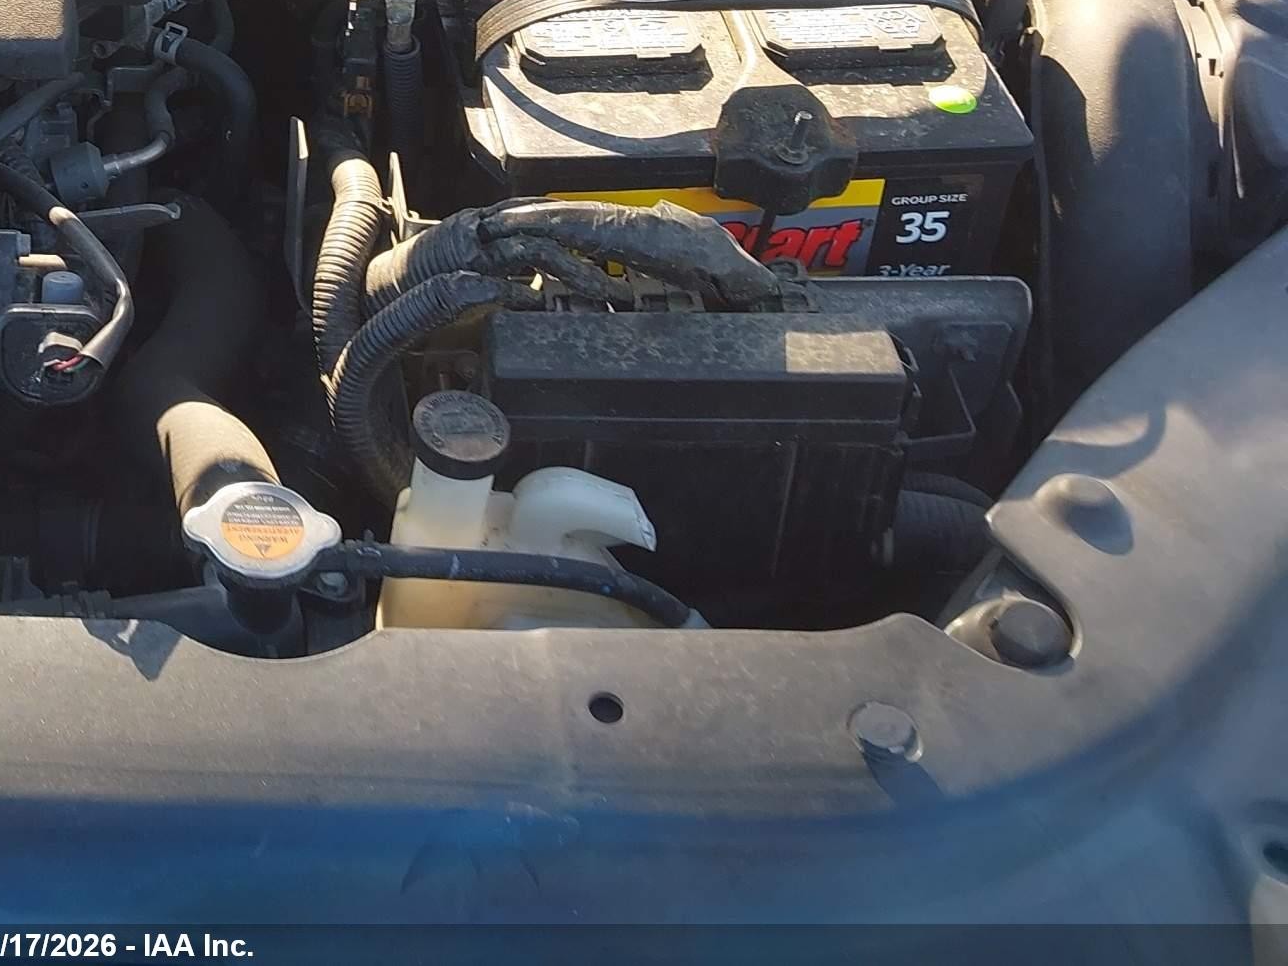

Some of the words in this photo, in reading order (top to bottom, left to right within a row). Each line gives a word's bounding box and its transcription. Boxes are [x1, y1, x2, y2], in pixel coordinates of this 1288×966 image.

[891, 195, 938, 206] GROUP
[939, 193, 968, 203] SIZE
[895, 210, 951, 245] 35
